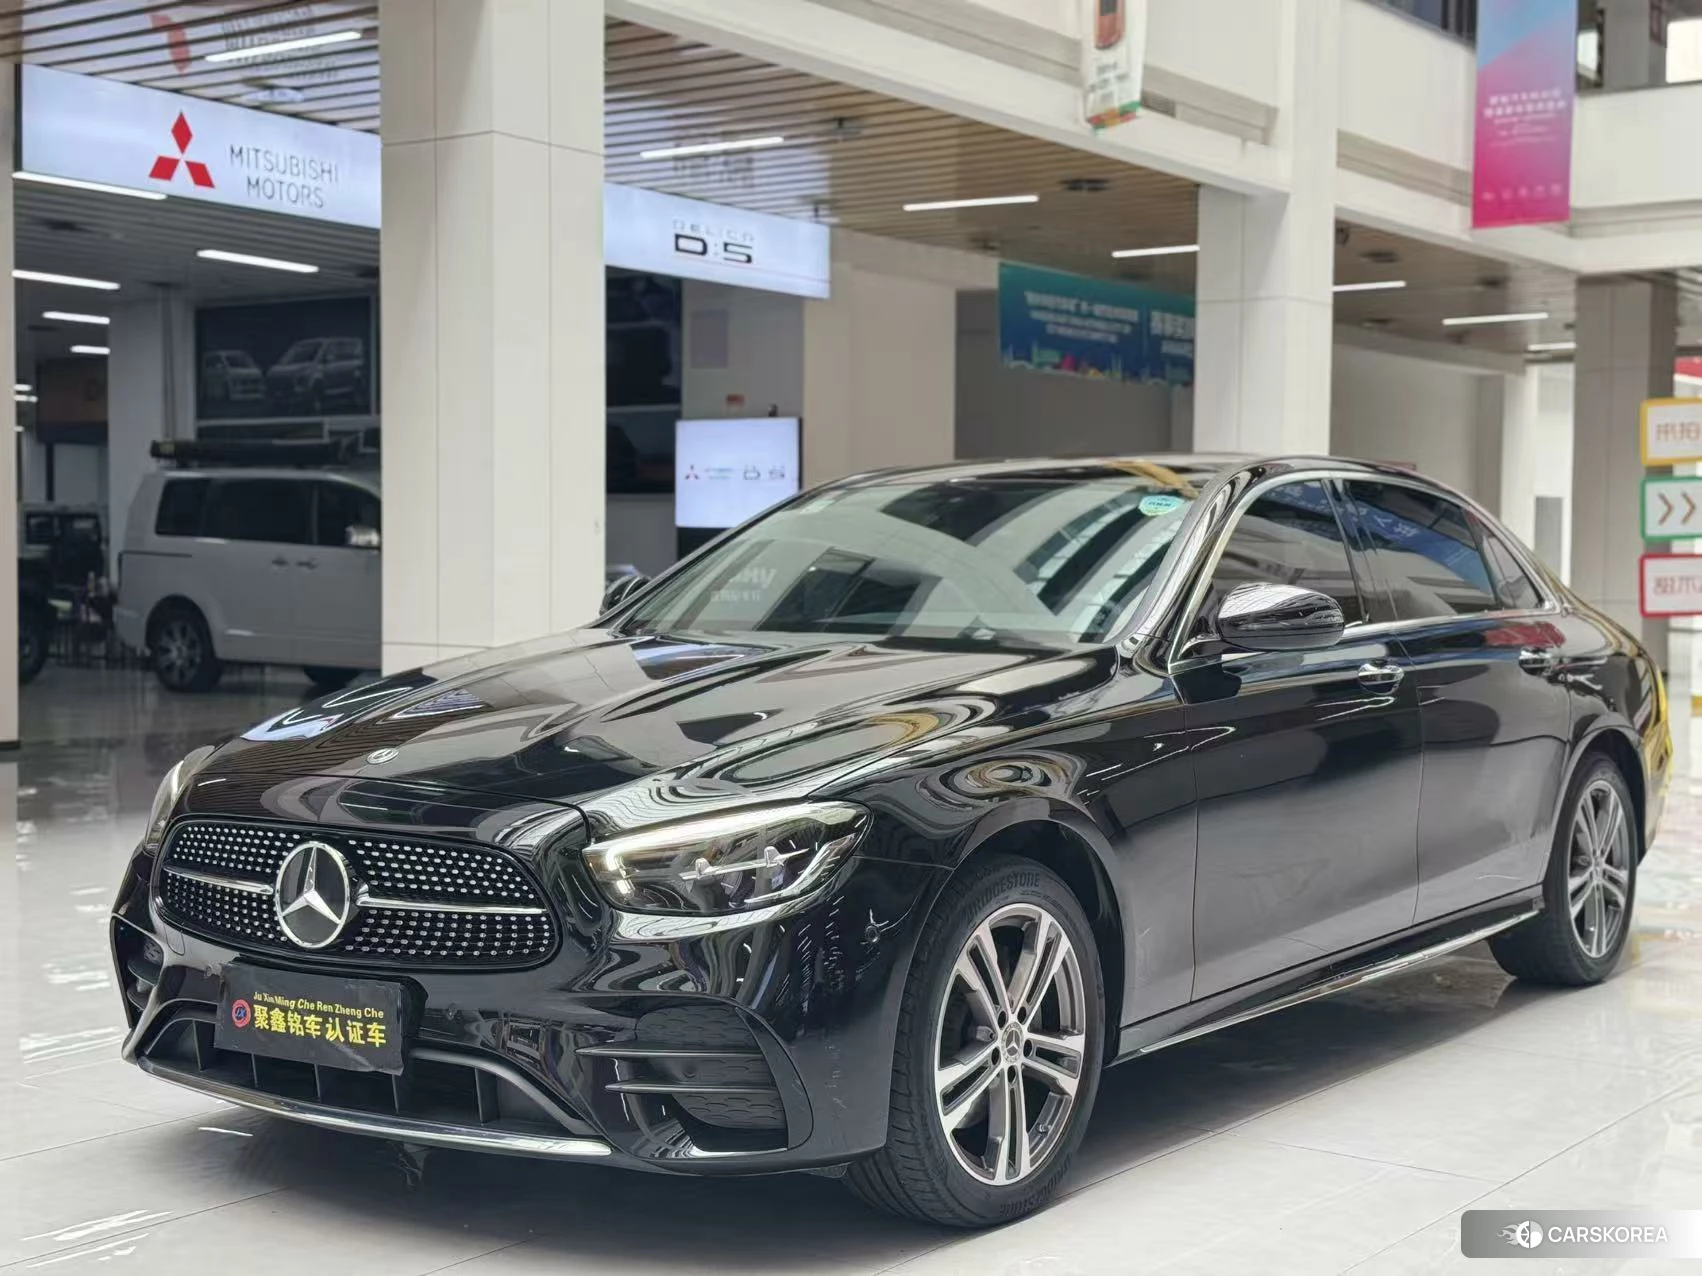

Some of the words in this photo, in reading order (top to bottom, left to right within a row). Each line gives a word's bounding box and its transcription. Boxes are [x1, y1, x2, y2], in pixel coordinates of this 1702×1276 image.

[230, 144, 338, 183] MITSUBISHI
[246, 175, 325, 209] MOTORS
[675, 233, 752, 264] D:5
[253, 991, 263, 1001] Ju
[263, 992, 275, 1003] Xin
[274, 995, 296, 1010] Ming
[297, 998, 315, 1011] Che
[316, 1000, 334, 1014] Ren
[335, 1003, 362, 1019] Zheng
[364, 1006, 385, 1019] Che
